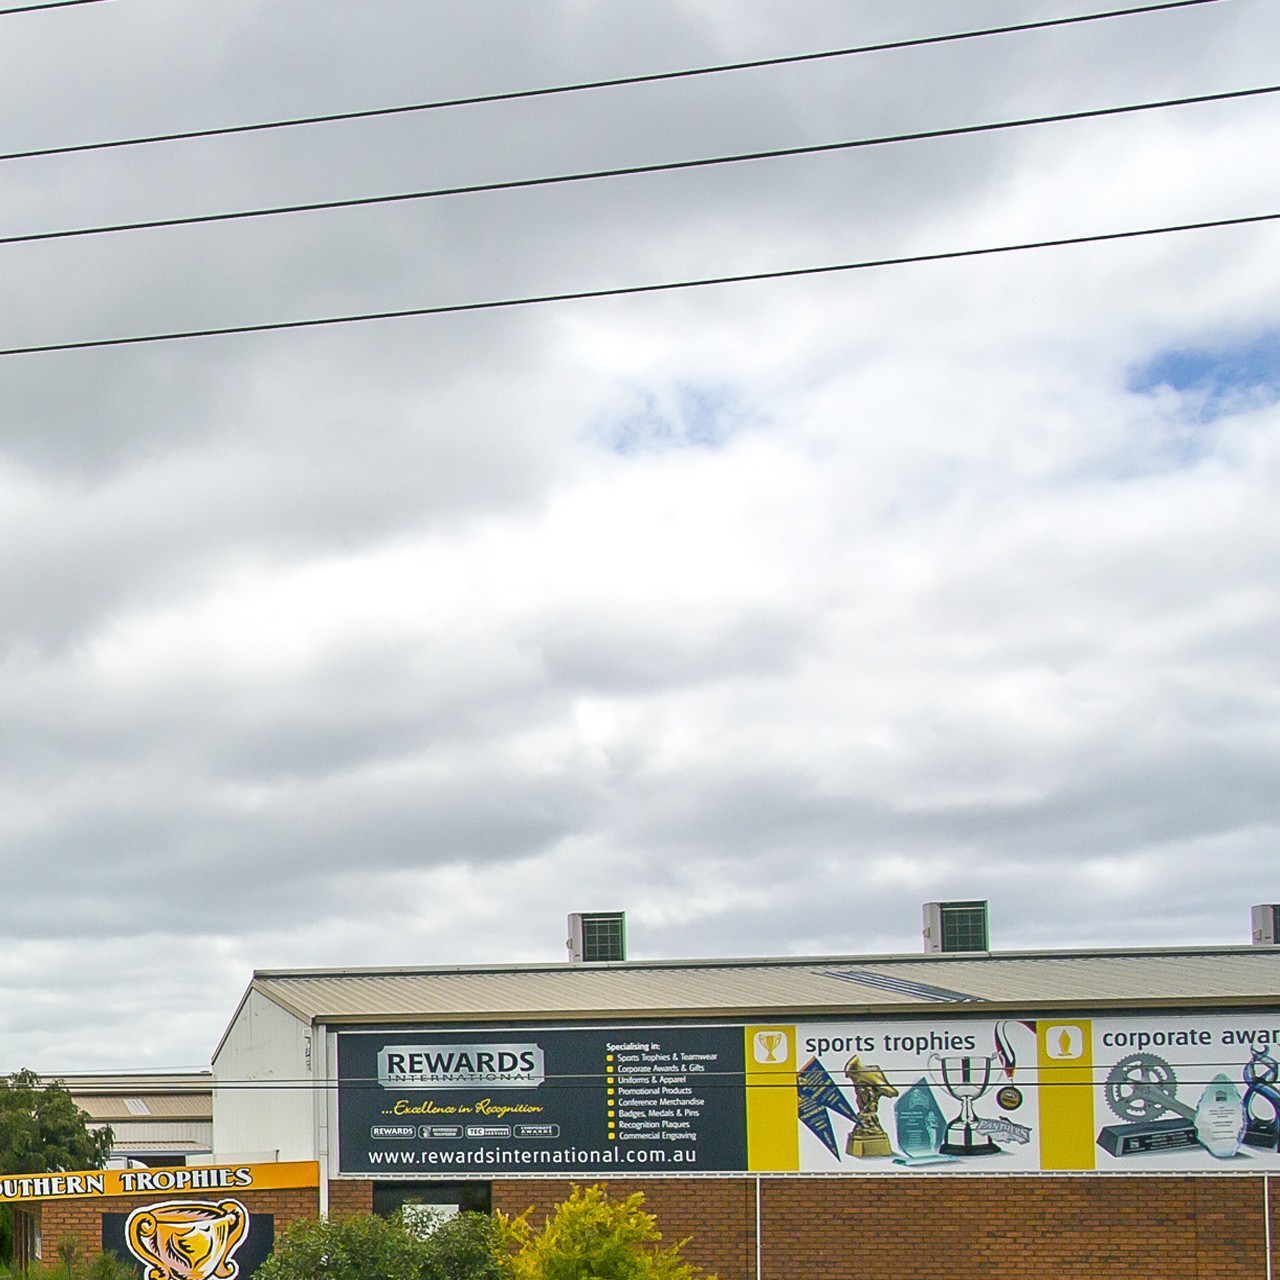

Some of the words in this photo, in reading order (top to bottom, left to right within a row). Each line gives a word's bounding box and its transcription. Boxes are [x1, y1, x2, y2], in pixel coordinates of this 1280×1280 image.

[806, 1034, 875, 1056] sports
[883, 1031, 976, 1055] trophies
[1102, 1029, 1212, 1050] corporate
[1221, 1029, 1280, 1044] awar
[606, 1042, 649, 1052] Specialising
[387, 1051, 535, 1074] REWARDS
[617, 1053, 639, 1062] Sports
[642, 1053, 670, 1062] Trophies
[617, 1065, 651, 1073] Corporate
[689, 1064, 705, 1072] Gifts
[388, 1073, 535, 1082] INTERNATIONAL
[659, 1076, 686, 1084] Apparel
[618, 1087, 660, 1095] Promotional
[618, 1098, 657, 1106] Conference
[660, 1098, 705, 1106] Merchandise
[458, 1104, 472, 1113] in
[475, 1098, 543, 1118] Recognition
[619, 1109, 646, 1119] Badges,
[648, 1109, 674, 1117] Medals
[684, 1109, 700, 1117] Pins
[619, 1121, 660, 1130] Recognition
[662, 1120, 690, 1129] Plaques
[373, 1127, 414, 1136] REWARDS
[619, 1131, 660, 1140] Commercial
[662, 1131, 697, 1141] Engraving
[368, 1146, 696, 1165] www.rewardsinternational.com.au
[119, 1167, 254, 1193] TROPHIES
